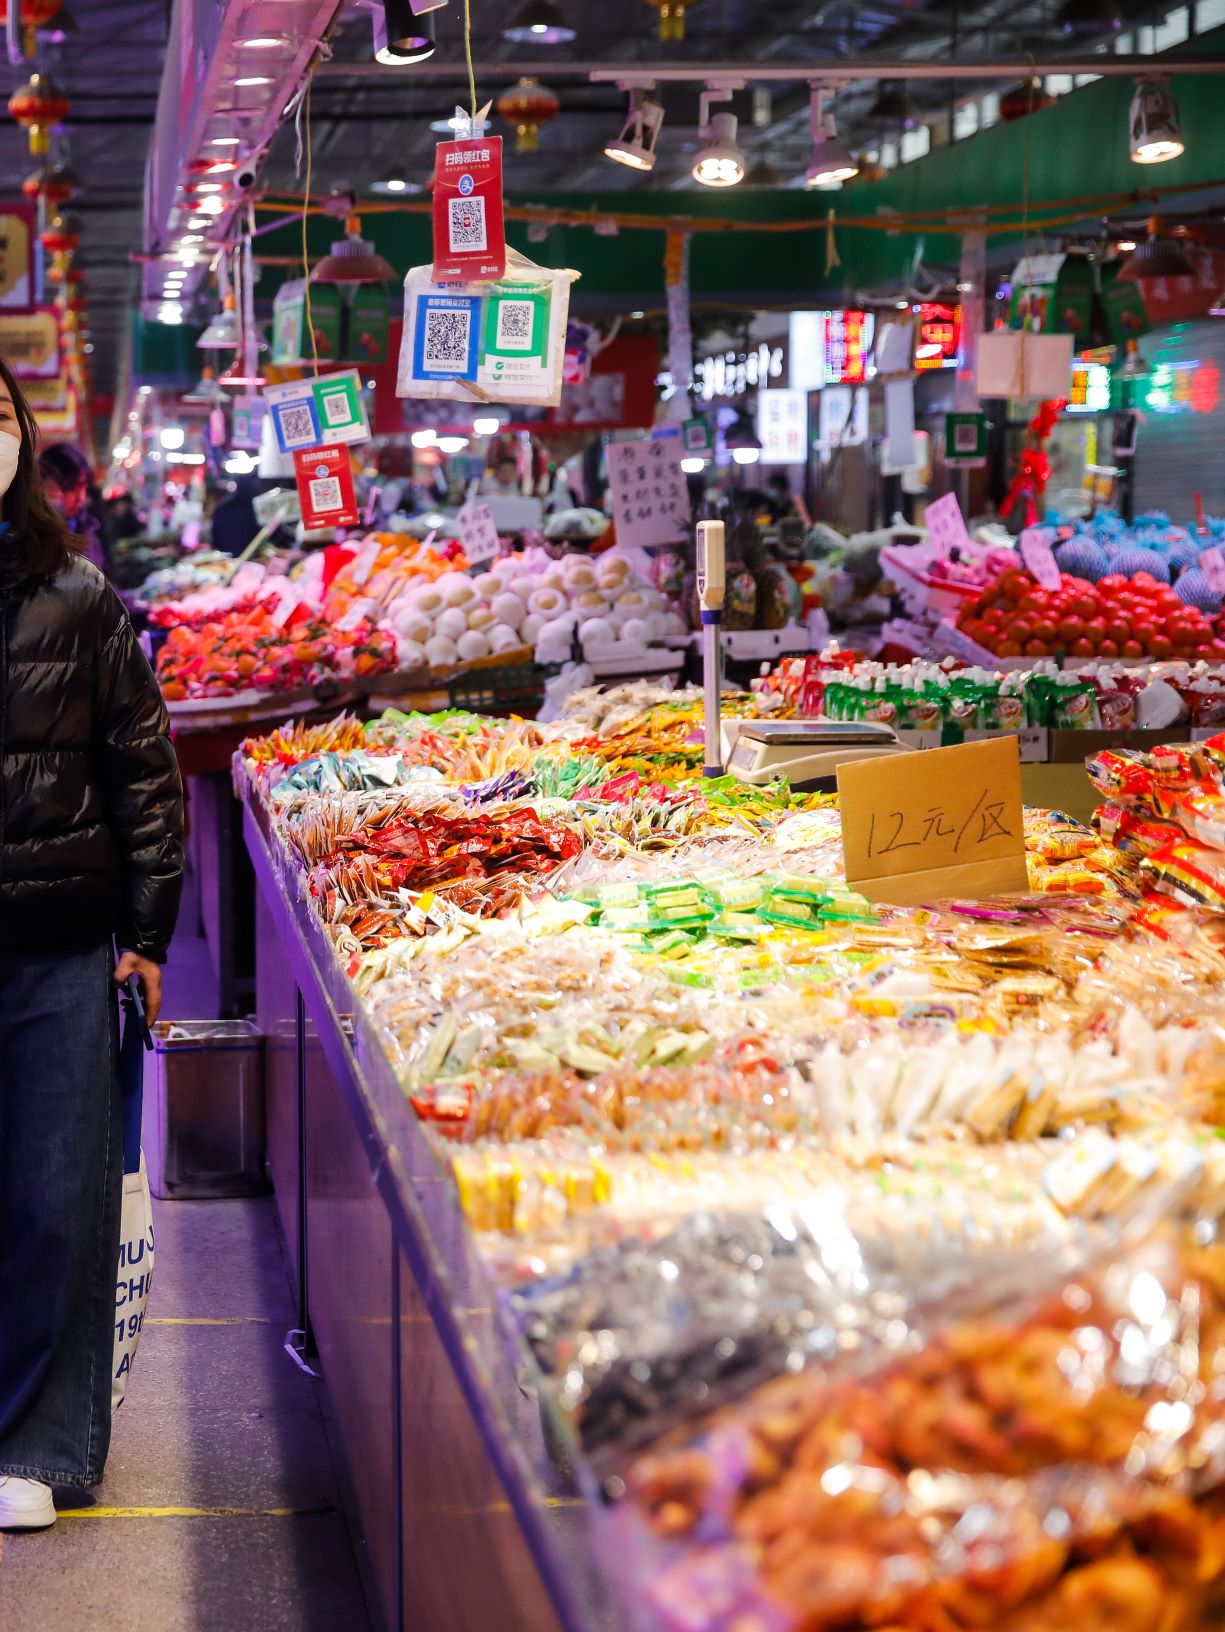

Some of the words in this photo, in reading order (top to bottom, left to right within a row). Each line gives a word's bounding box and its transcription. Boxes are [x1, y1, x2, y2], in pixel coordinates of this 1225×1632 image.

[445, 149, 490, 166] 扫码领红包
